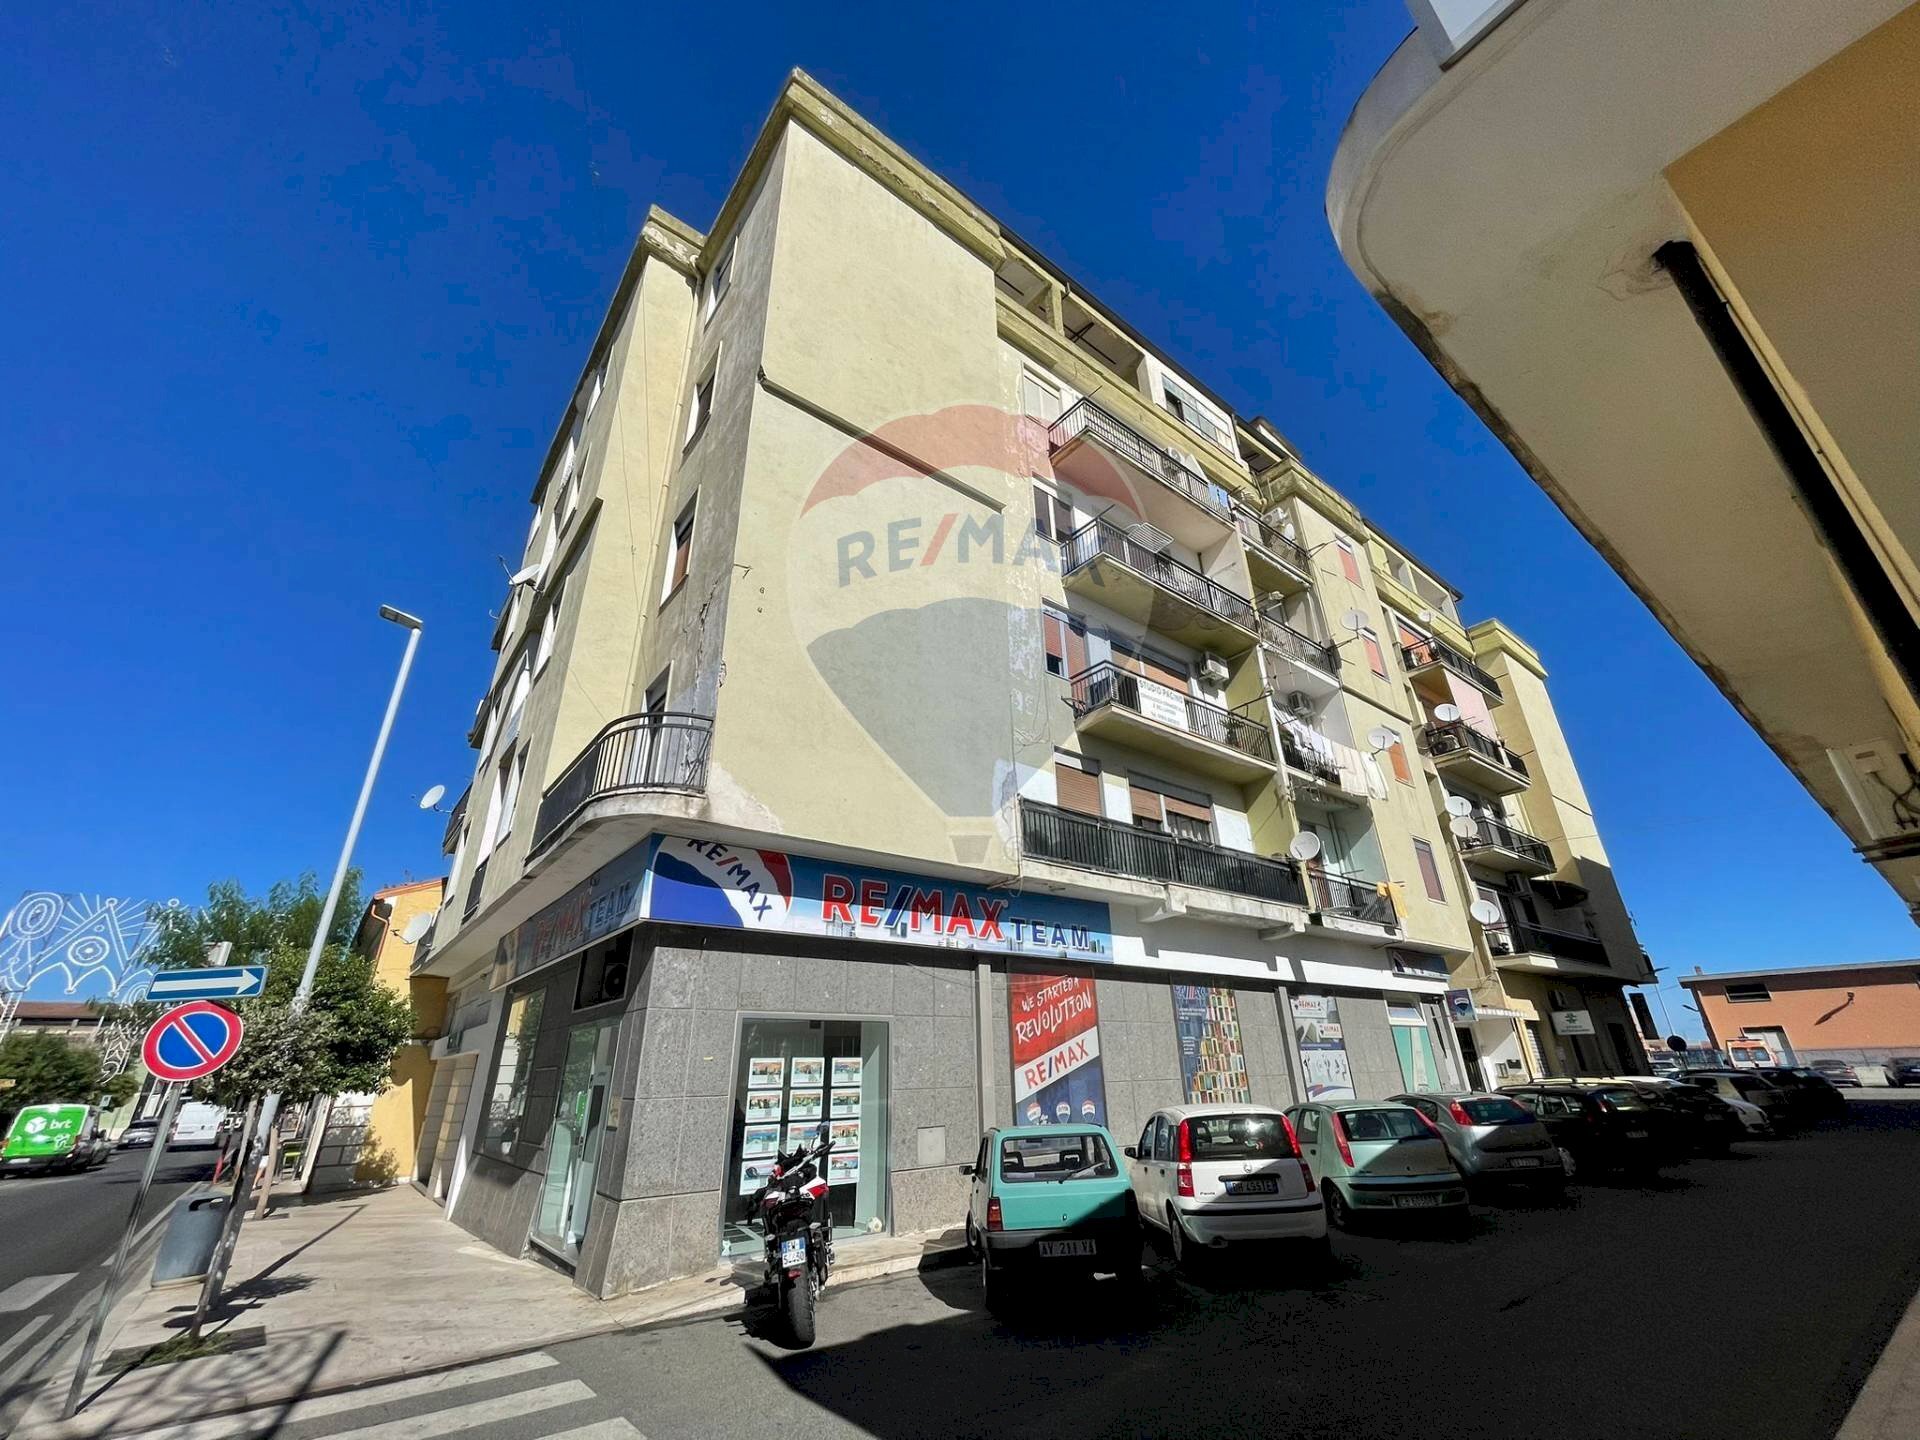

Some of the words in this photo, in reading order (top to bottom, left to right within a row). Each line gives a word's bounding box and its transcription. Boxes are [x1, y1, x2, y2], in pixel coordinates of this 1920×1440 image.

[687, 839, 773, 922] RE/MAX
[821, 873, 1006, 941] RE/MAX
[1009, 916, 1091, 951] TEAM
[1016, 984, 1092, 1045] REVOLUTION
[1021, 993, 1035, 1012] WE
[1037, 977, 1074, 1007] STARTED
[1024, 1038, 1089, 1090] RE/MAX
[49, 1118, 73, 1130] brt
